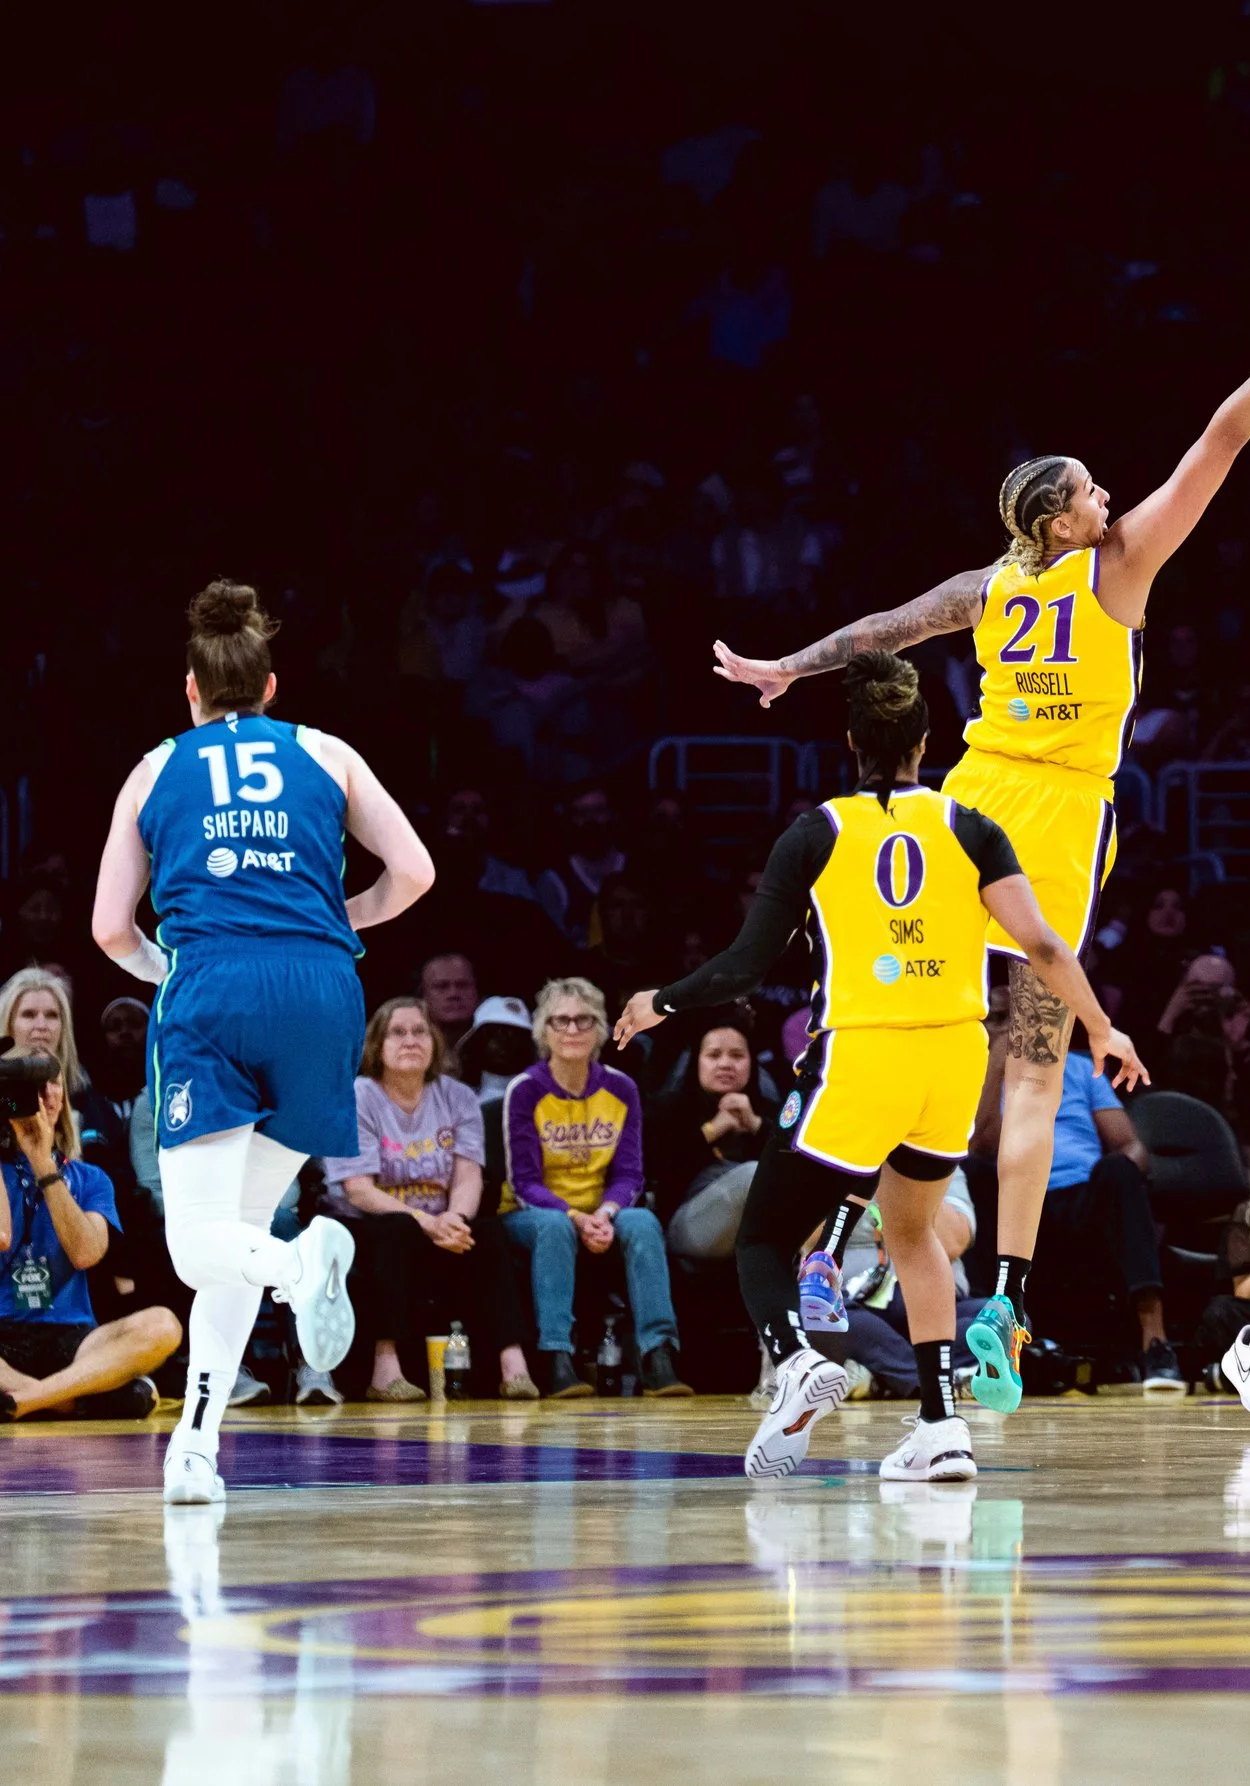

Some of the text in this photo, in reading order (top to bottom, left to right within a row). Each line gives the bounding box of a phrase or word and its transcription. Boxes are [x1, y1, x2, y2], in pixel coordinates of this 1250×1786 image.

[999, 590, 1079, 664] 21
[1015, 671, 1073, 696] RUSSELL
[1035, 703, 1083, 720] AT&T
[198, 741, 284, 807] 15
[202, 809, 288, 840] SHEPARD
[241, 849, 296, 872] AT&T
[874, 831, 926, 910] 0
[889, 918, 924, 944] SIMS
[540, 1116, 615, 1143] Sparks
